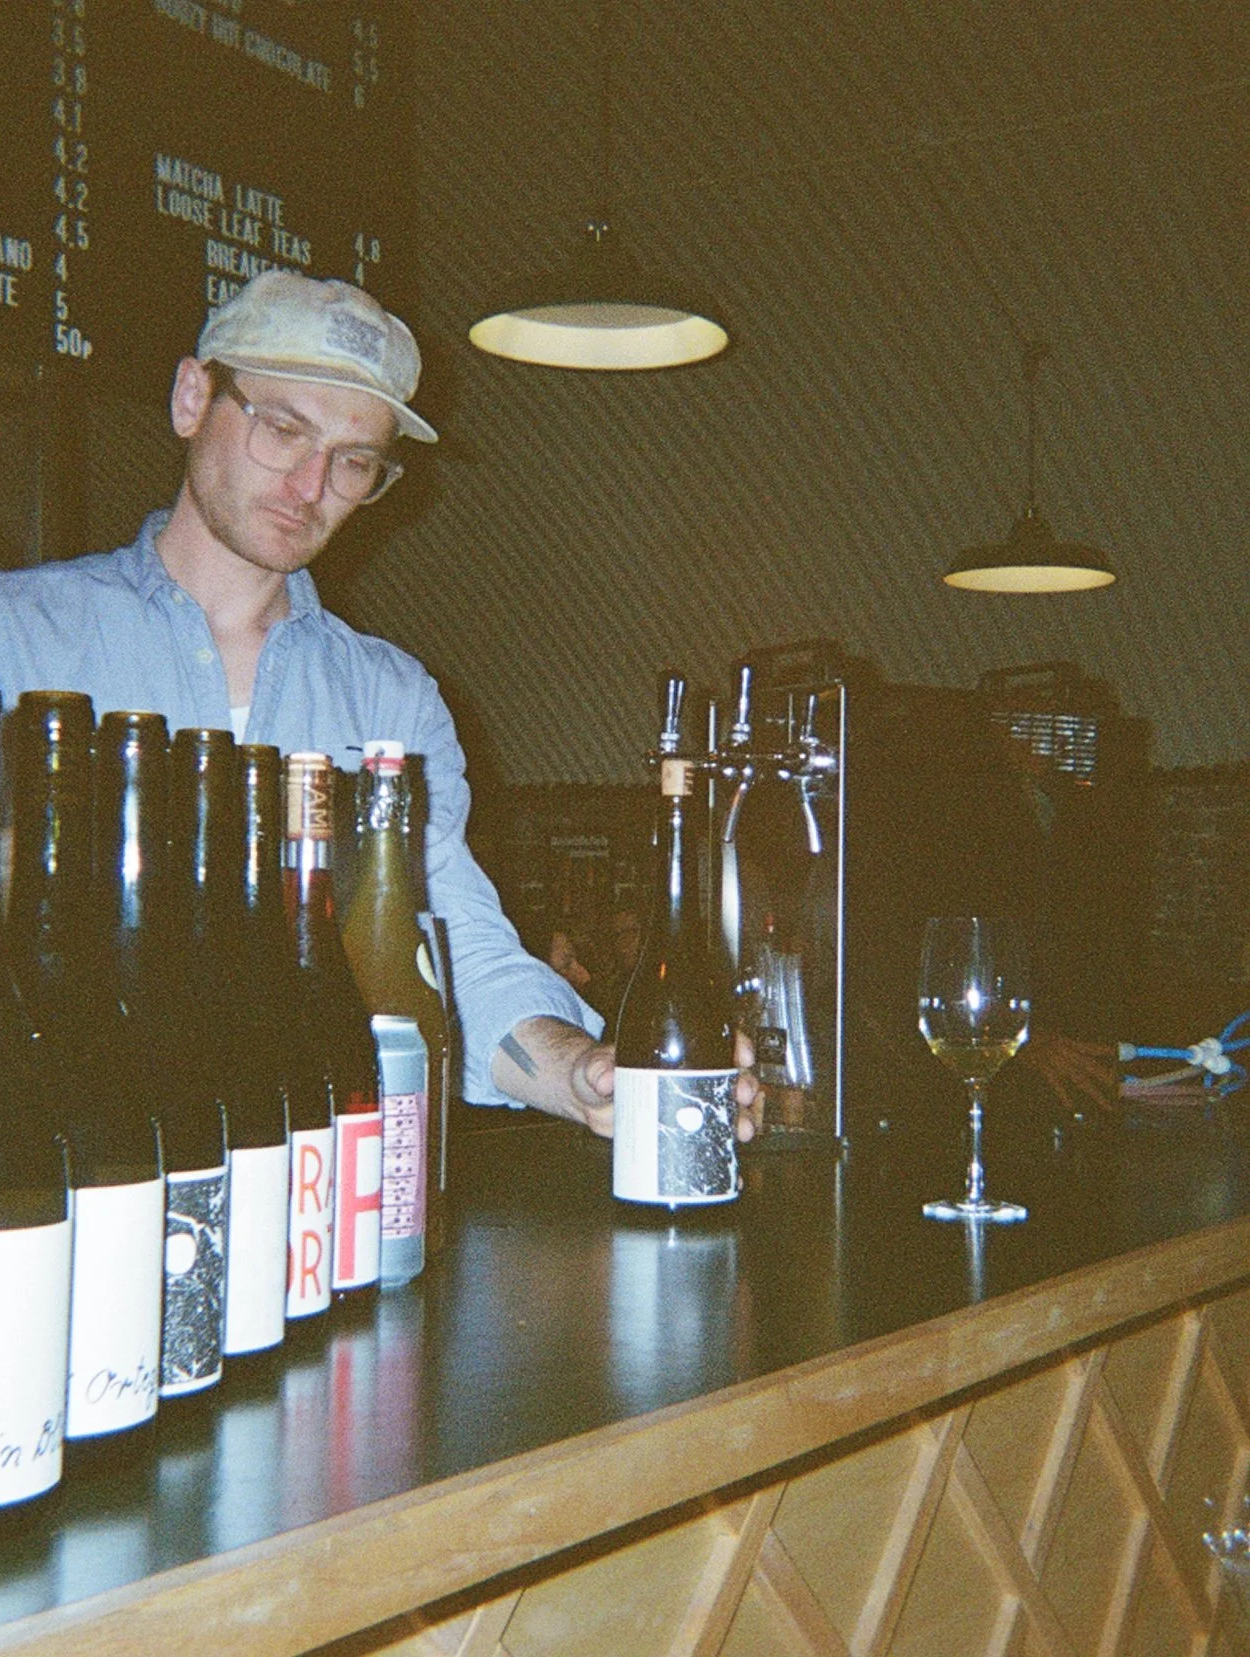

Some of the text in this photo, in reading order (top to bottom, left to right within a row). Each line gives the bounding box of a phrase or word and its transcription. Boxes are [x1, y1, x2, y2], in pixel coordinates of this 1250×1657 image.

[52, 96, 84, 134] 4.1
[52, 134, 90, 175] 4.2
[52, 174, 91, 214] 4.2
[155, 151, 287, 229] MATCHA LATTE
[53, 212, 91, 252] 4.5
[155, 183, 313, 268] LOOSE LEAF TEAS
[54, 252, 69, 284] 4
[206, 238, 303, 280] BREAKF
[55, 290, 70, 322] 5
